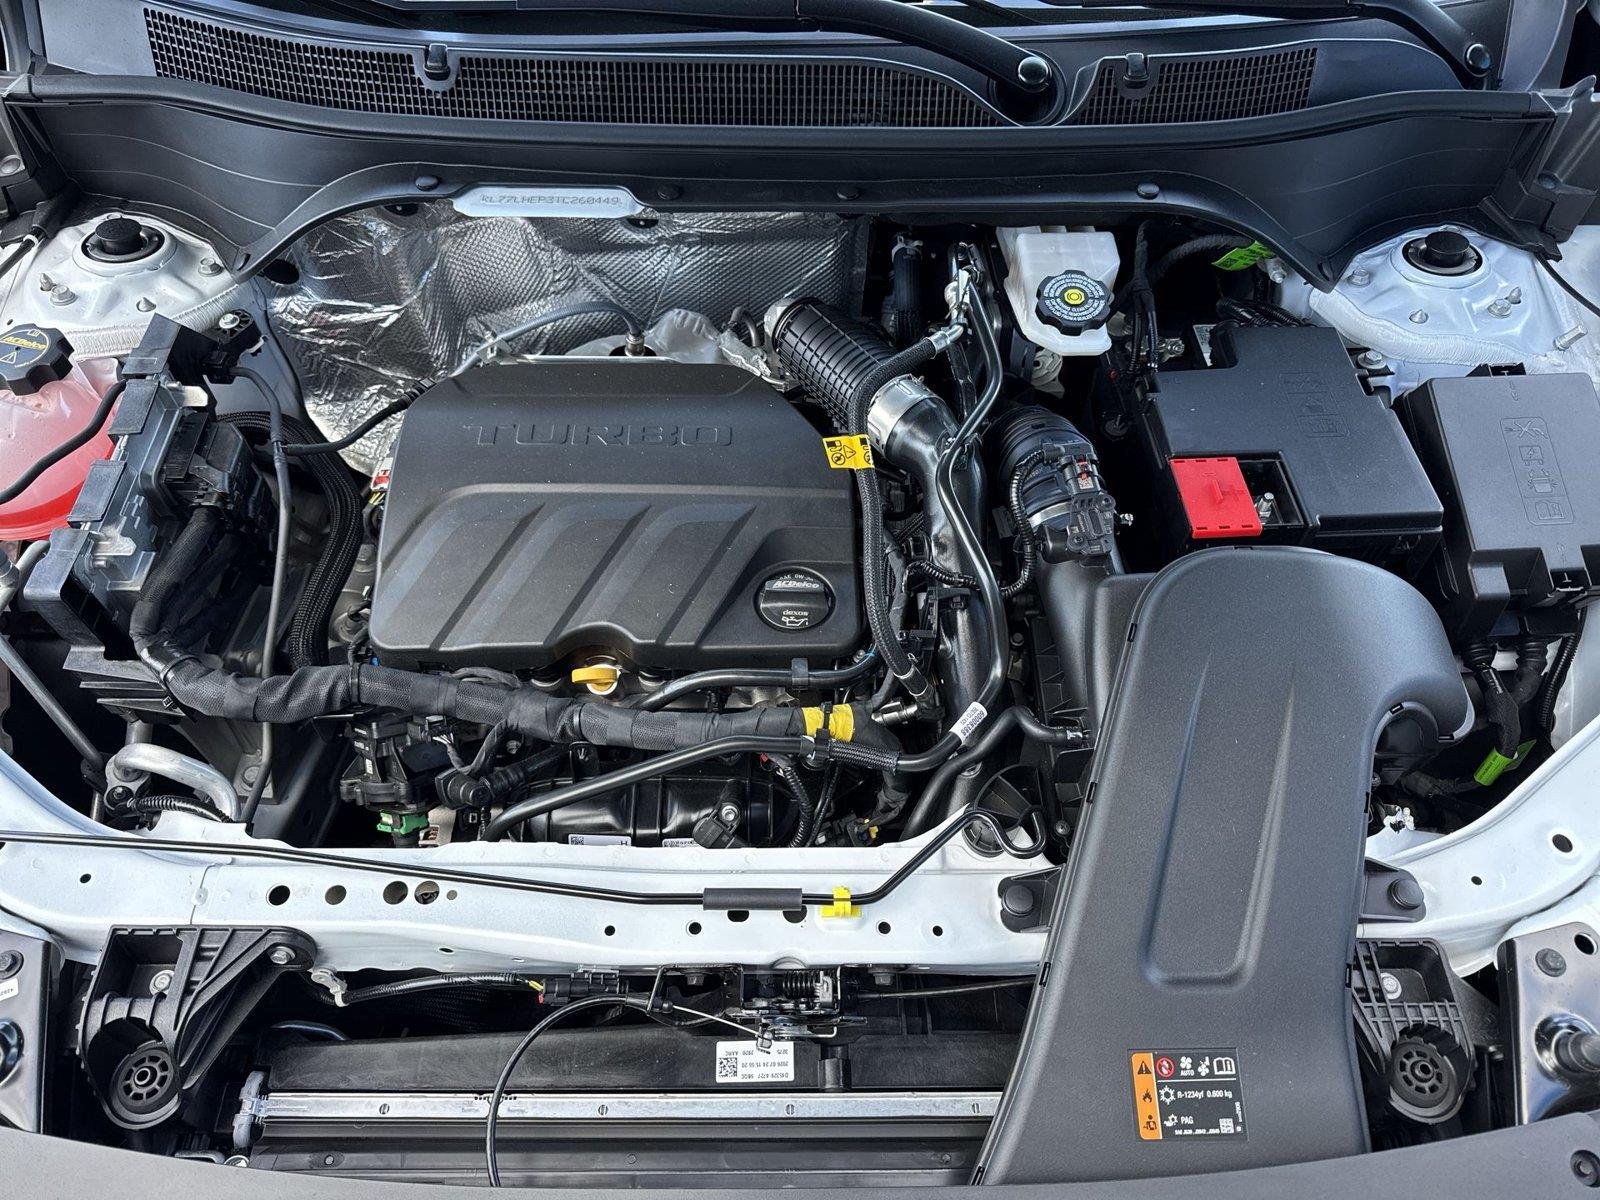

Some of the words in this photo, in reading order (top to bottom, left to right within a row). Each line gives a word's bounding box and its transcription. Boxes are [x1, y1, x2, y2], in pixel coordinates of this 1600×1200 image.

[464, 424, 732, 446] TURBO
[1177, 1091, 1204, 1100] R-1234yf
[1225, 1090, 1232, 1098] kg
[1181, 1116, 1194, 1124] PAG
